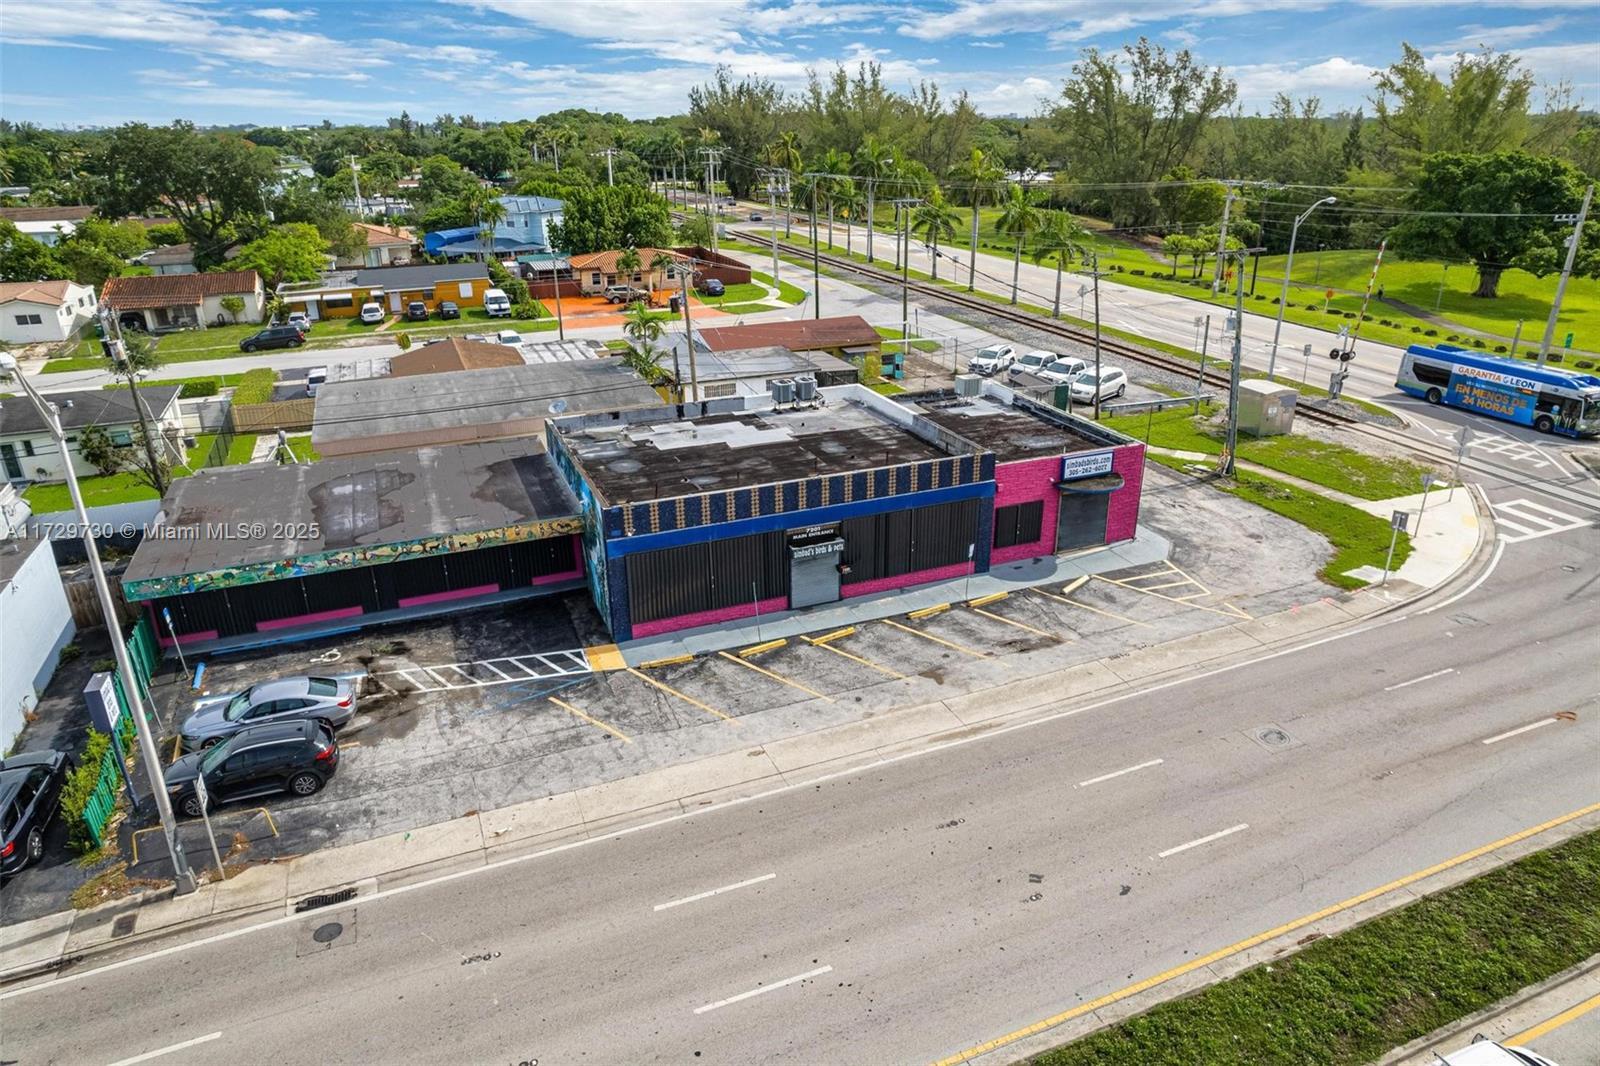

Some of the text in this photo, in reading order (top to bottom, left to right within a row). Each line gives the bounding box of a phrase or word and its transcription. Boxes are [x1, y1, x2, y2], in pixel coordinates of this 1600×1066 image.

[1458, 366, 1501, 381] GARANTIA
[1455, 383, 1471, 395] EN
[1472, 388, 1510, 404] MENOS
[1511, 397, 1527, 408] DE
[1462, 395, 1515, 415] 24 HORAS
